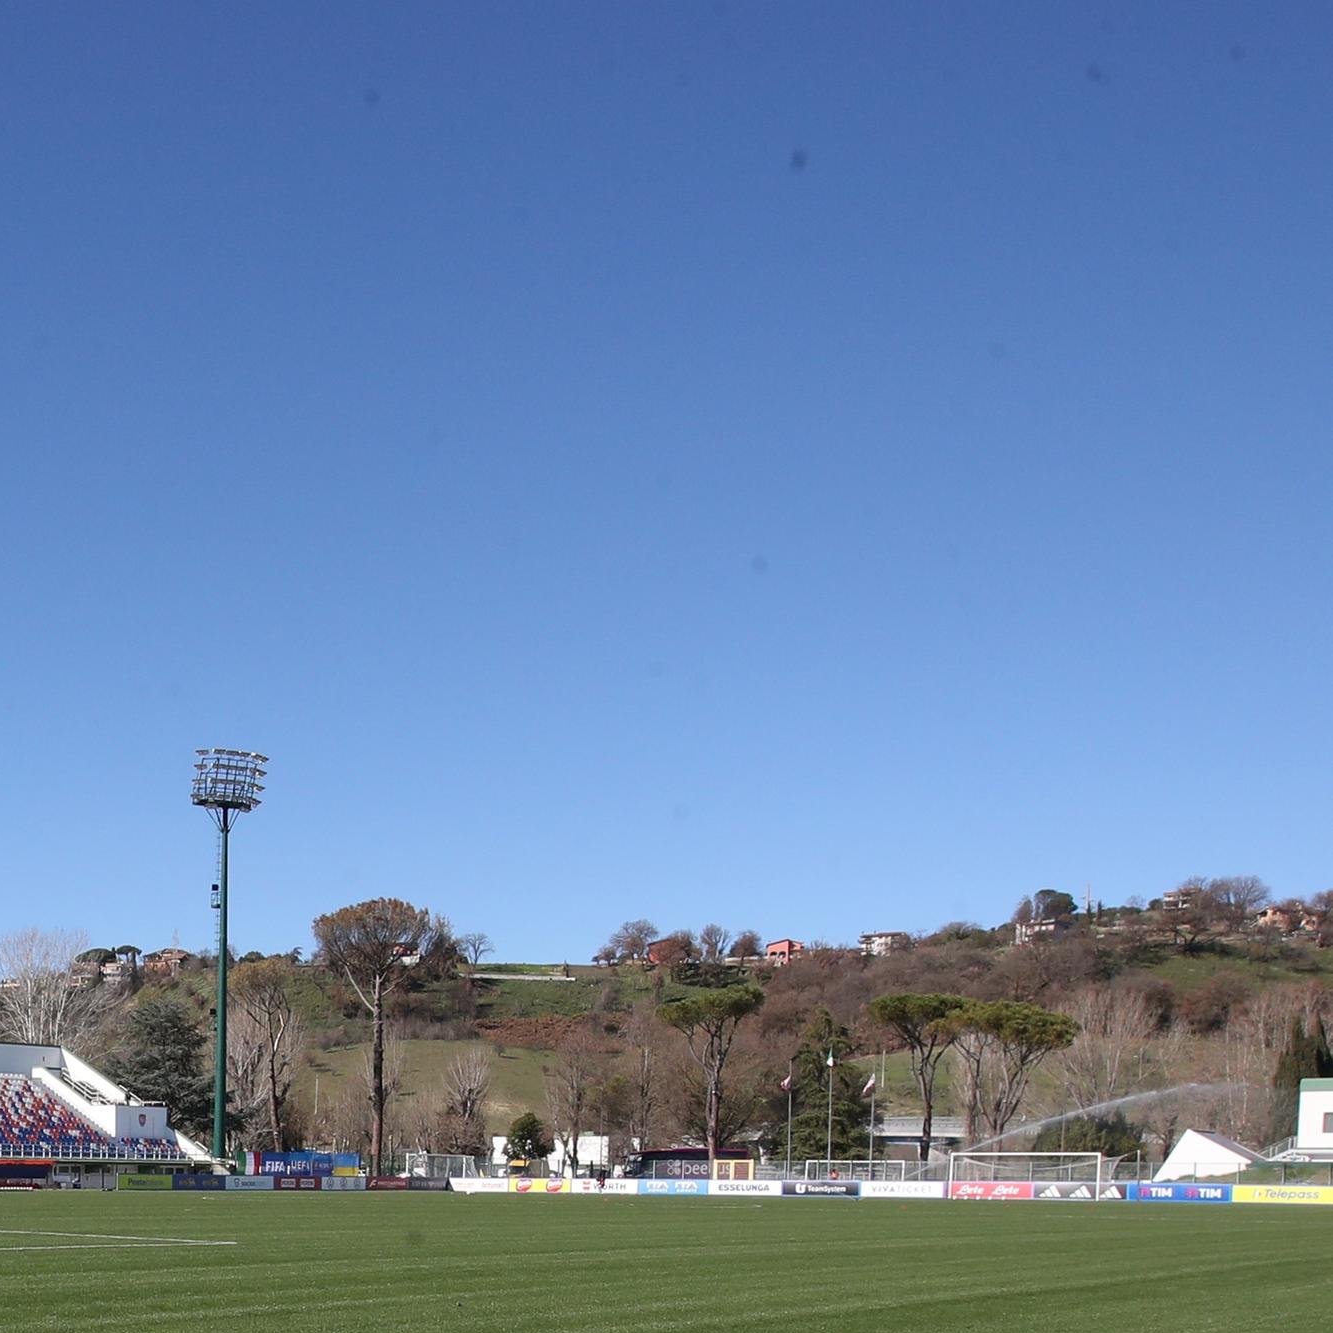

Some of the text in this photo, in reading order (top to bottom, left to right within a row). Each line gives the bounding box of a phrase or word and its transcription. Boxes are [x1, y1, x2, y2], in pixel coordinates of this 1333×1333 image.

[266, 1161, 285, 1172] FIFA
[718, 1184, 770, 1192] ESSELUNGA
[807, 1184, 846, 1193] TeamSystem
[871, 1185, 932, 1194] VIVATICKET
[956, 1185, 1020, 1195] Lete Lete
[1150, 1187, 1222, 1198] TIM TIM
[1265, 1188, 1319, 1200] Telepass
